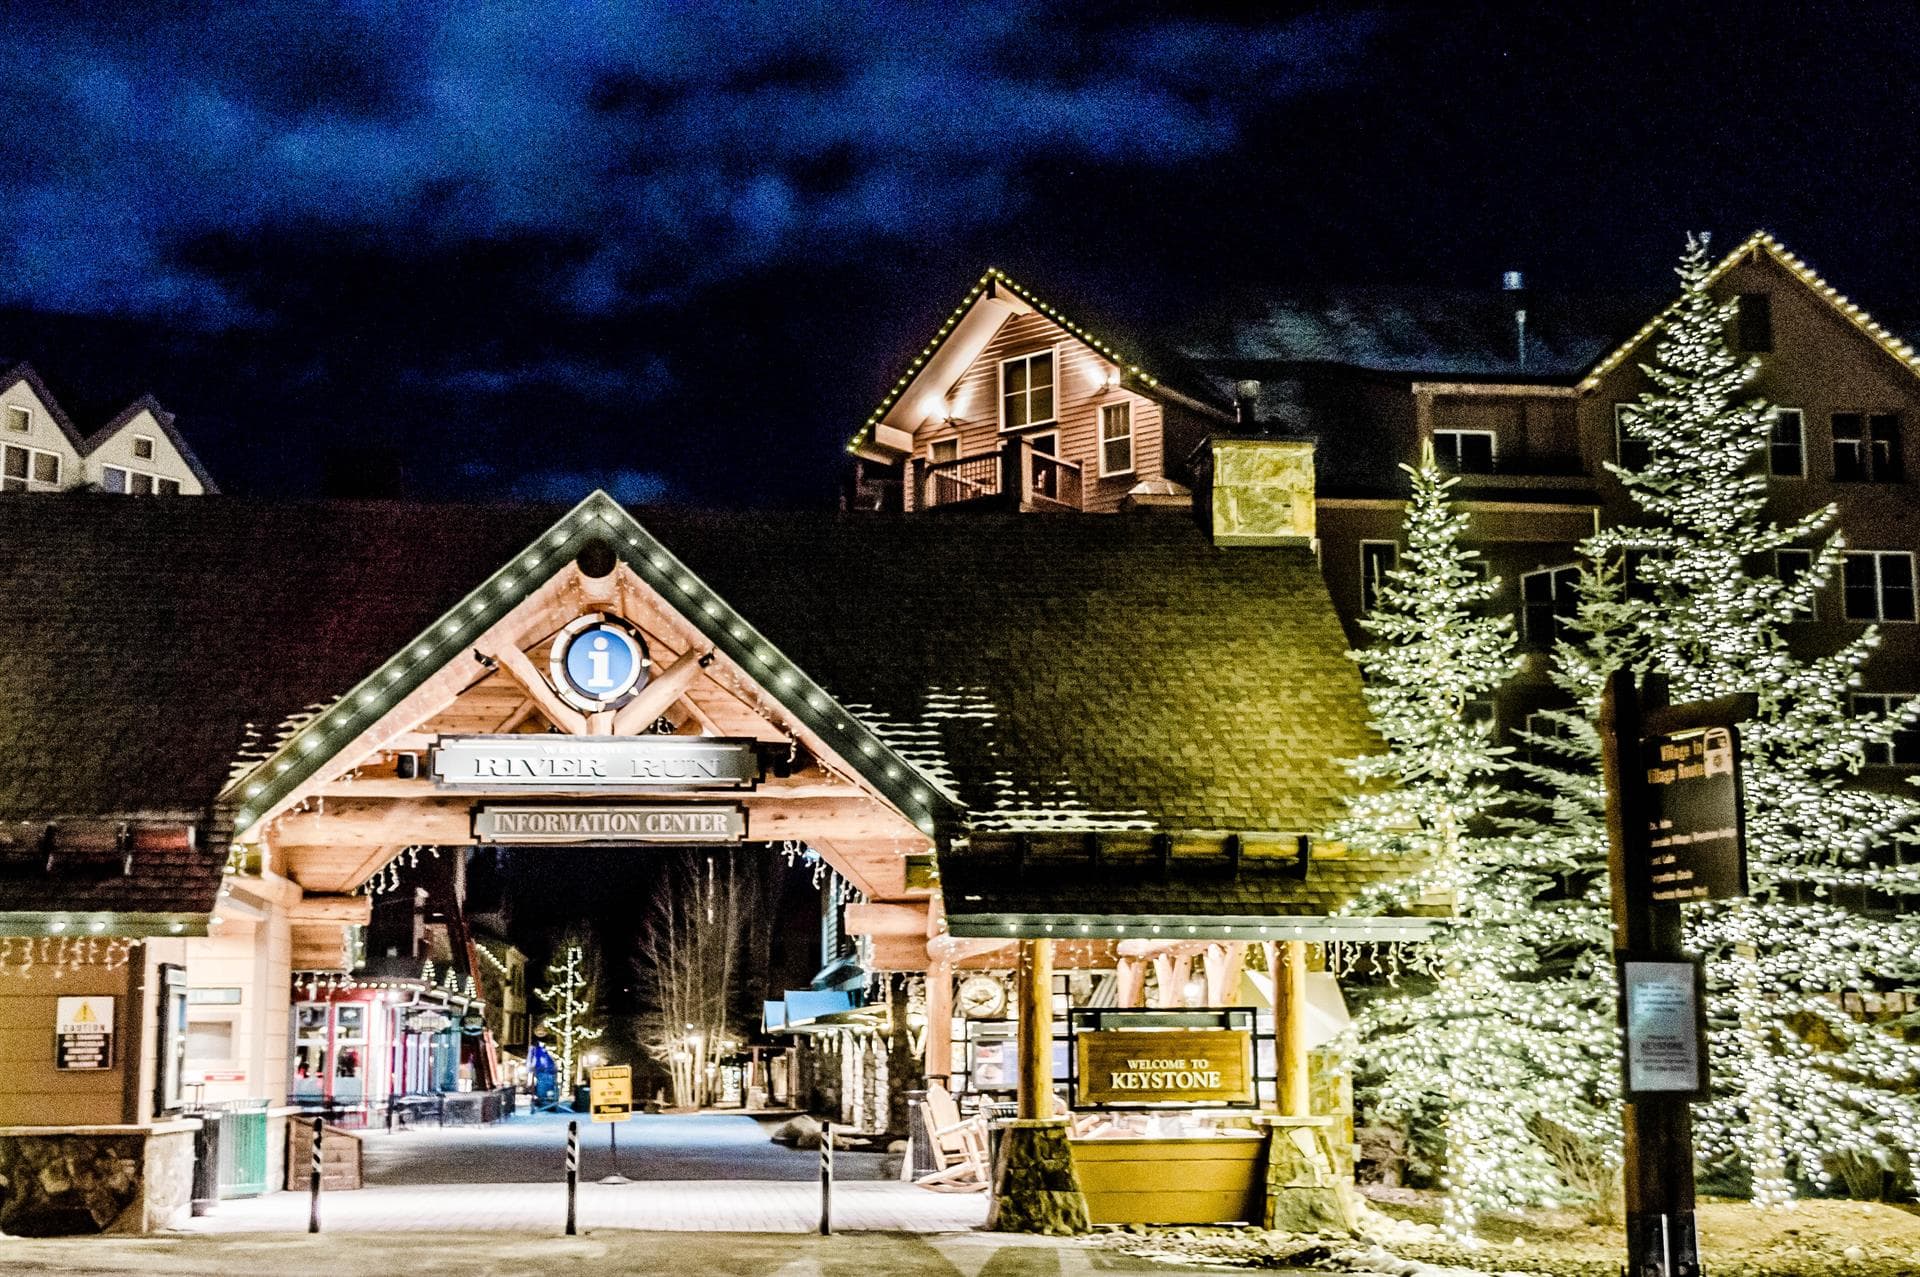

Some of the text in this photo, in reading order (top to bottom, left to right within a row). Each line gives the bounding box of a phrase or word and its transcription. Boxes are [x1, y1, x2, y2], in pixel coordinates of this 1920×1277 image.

[474, 759, 721, 778] RIVER RUN
[494, 813, 728, 832] INFORMATION CENTER
[63, 1024, 105, 1032] CAUTION
[1127, 1059, 1209, 1070] WELCOME TO
[1110, 1071, 1222, 1090] KEYSTONE
